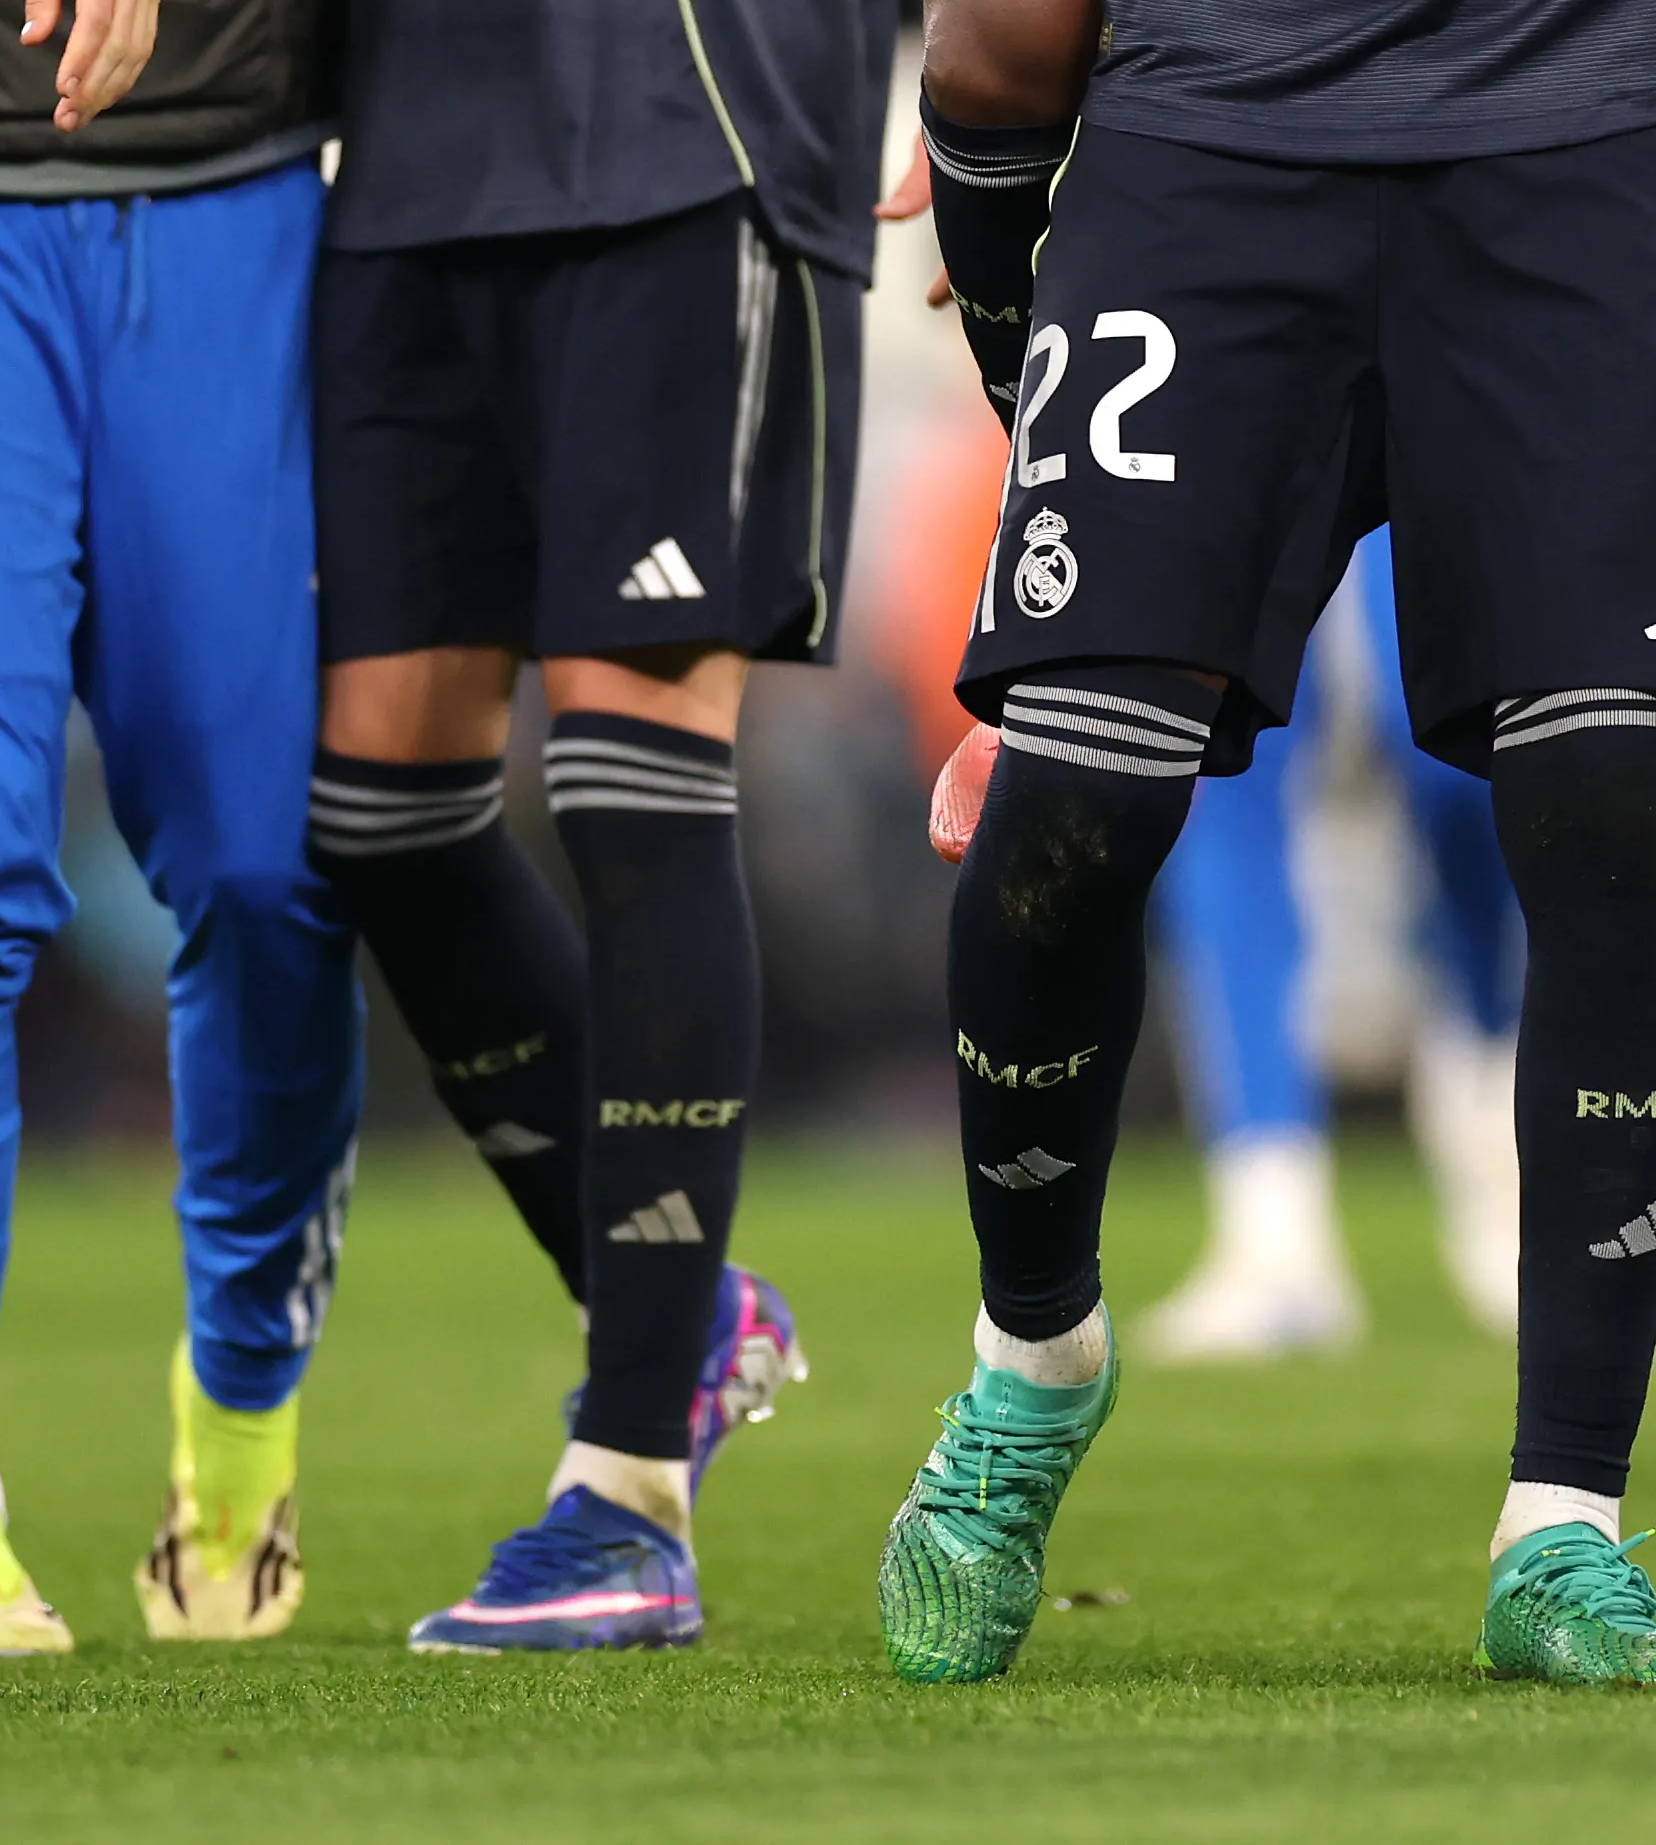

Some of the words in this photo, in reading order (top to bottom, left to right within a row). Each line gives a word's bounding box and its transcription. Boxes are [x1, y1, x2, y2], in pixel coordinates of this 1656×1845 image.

[1017, 309, 1177, 489] 22
[957, 1028, 1099, 1089] RMCF
[598, 1098, 747, 1128] RMCF
